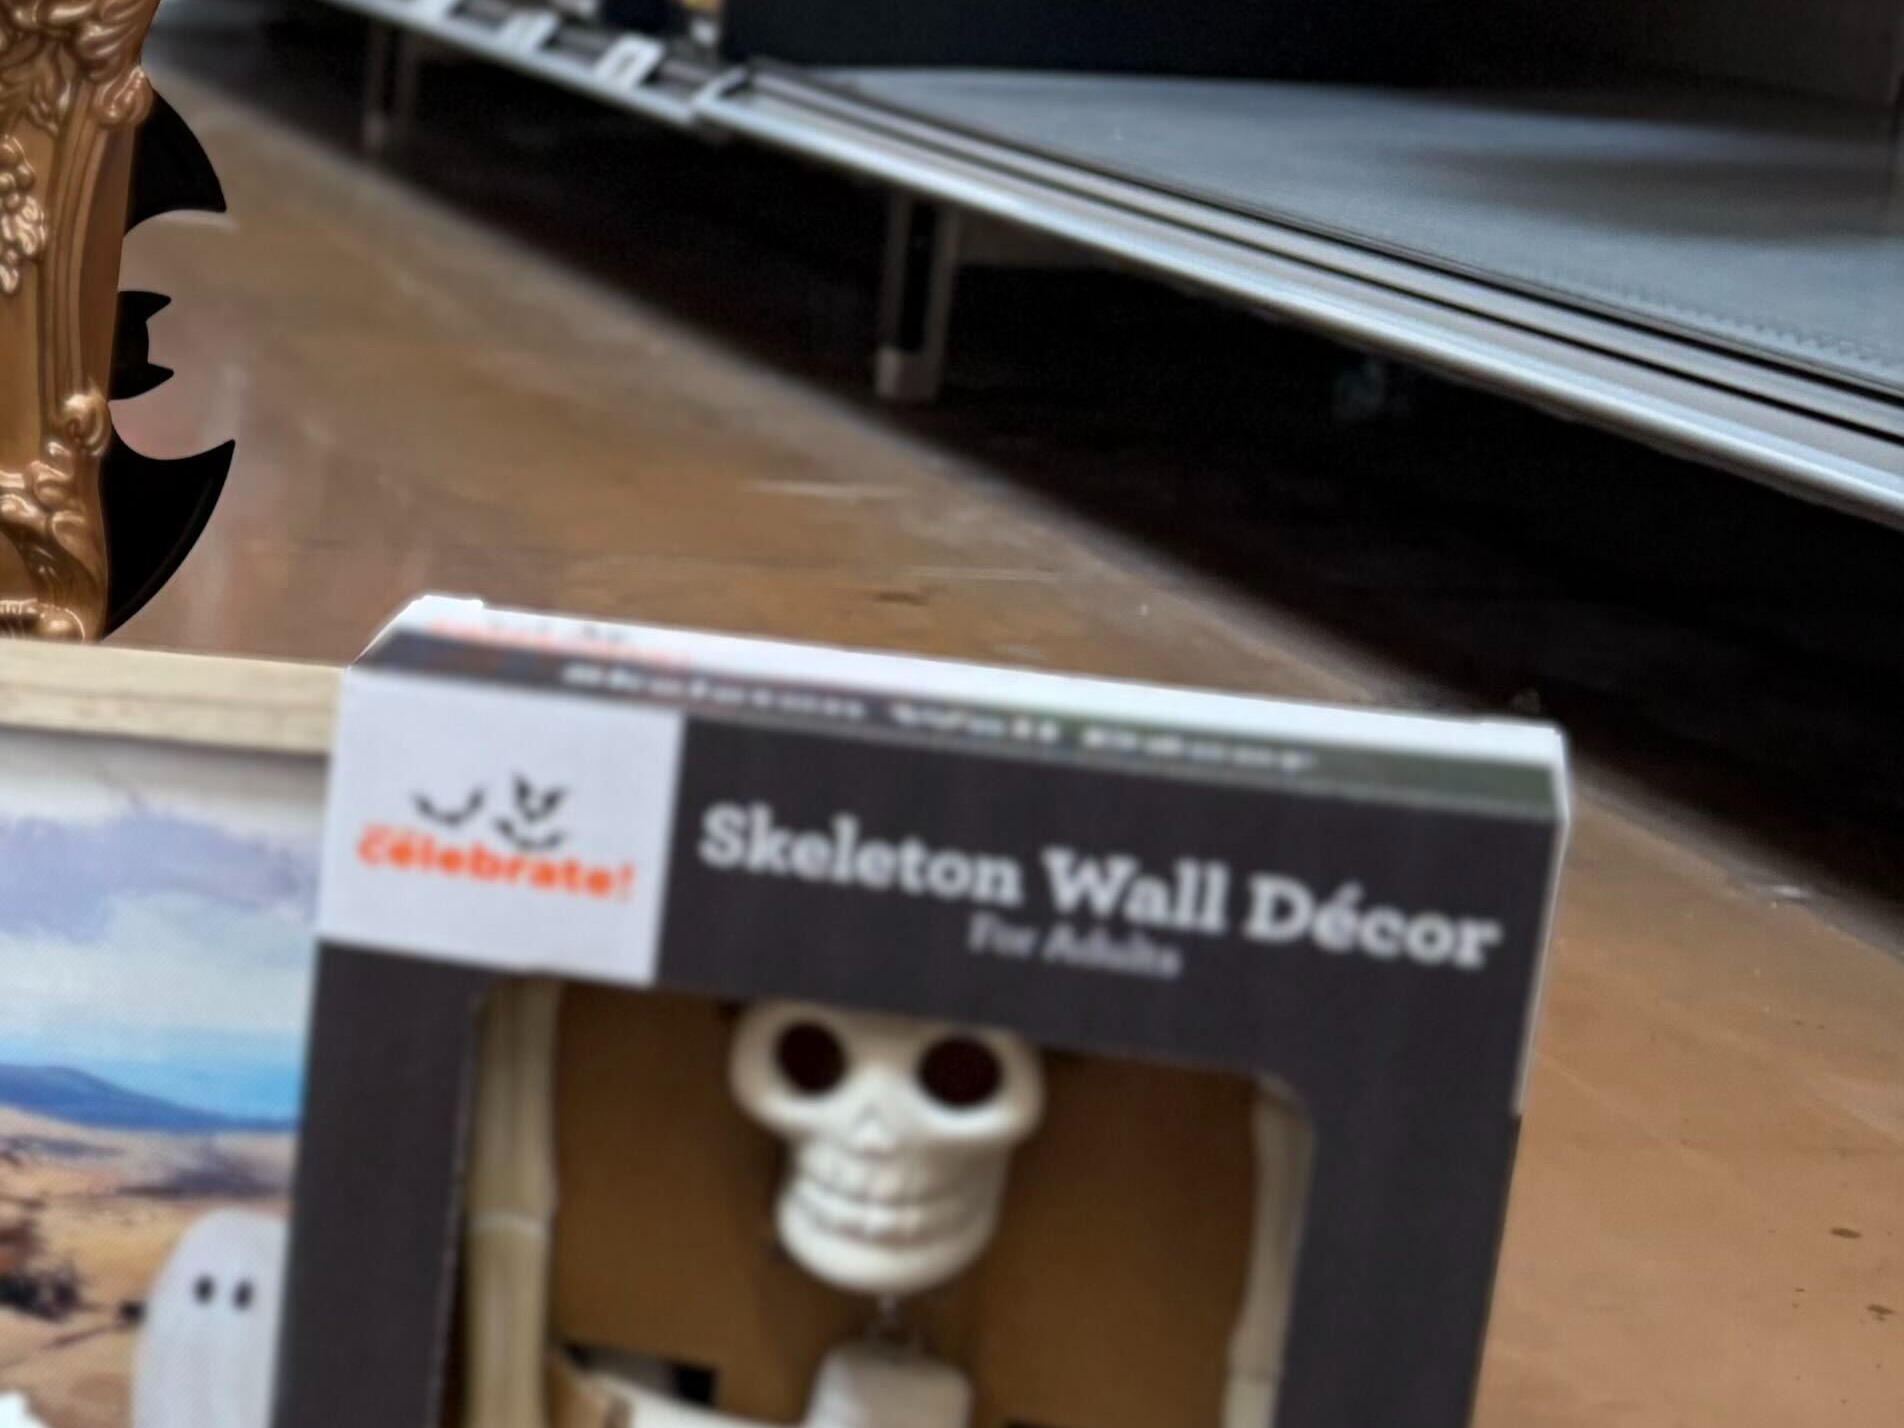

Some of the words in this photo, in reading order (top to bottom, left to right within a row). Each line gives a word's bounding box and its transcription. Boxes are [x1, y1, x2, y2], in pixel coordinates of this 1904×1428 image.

[700, 800, 1026, 906] Skeleton
[1040, 846, 1228, 936] Wall
[1242, 872, 1503, 969] Décor
[966, 912, 1034, 957] For
[1042, 925, 1184, 980] Adults
